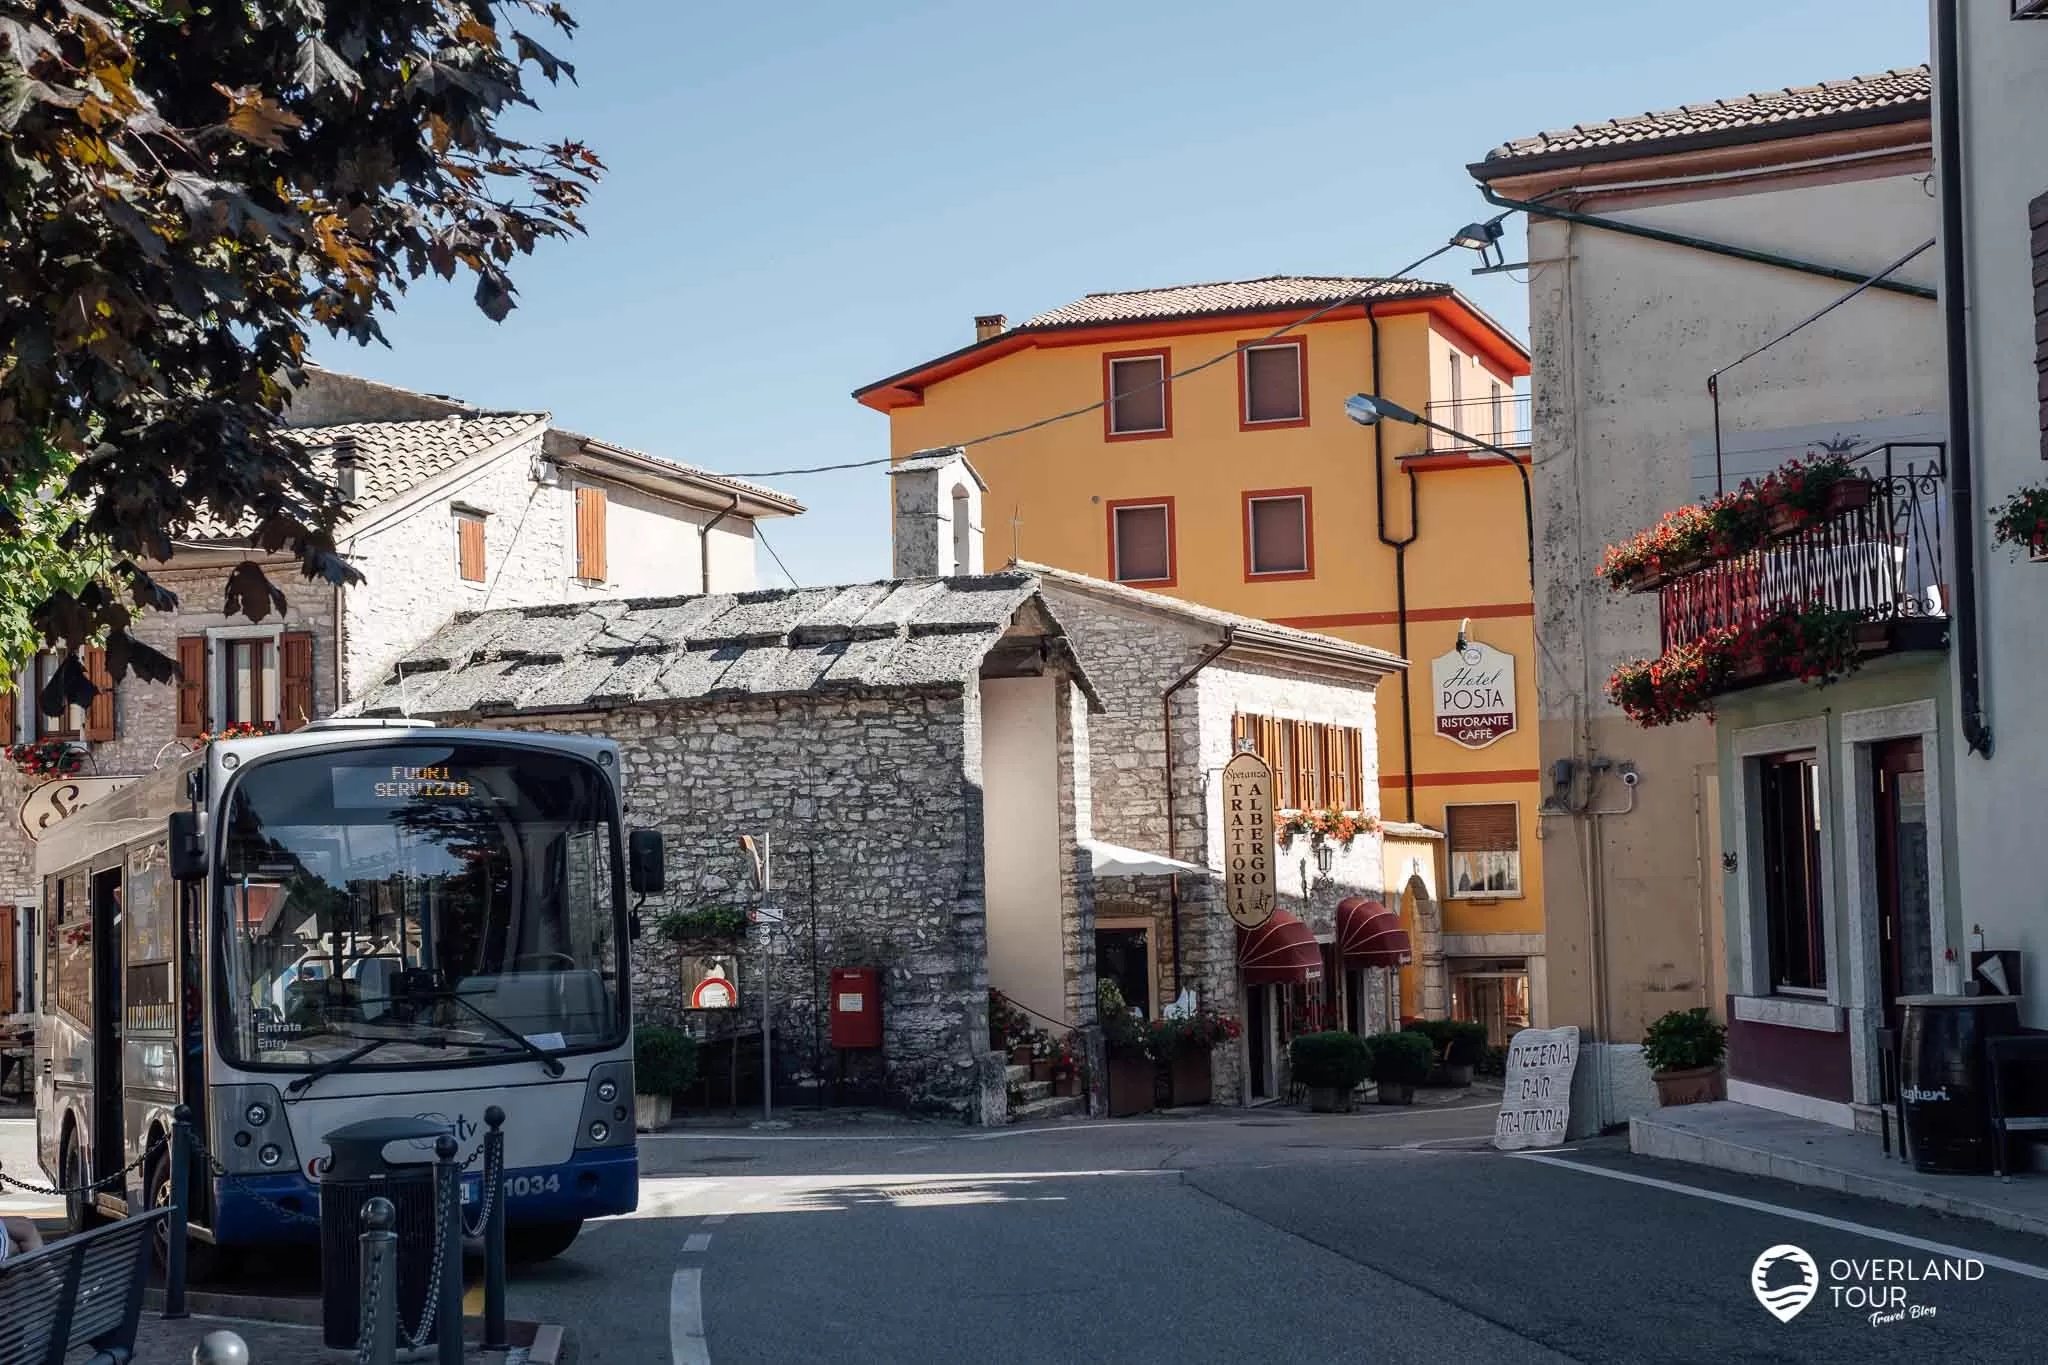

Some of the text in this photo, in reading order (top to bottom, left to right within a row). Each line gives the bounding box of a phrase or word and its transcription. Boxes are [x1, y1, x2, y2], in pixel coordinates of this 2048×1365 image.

[1443, 667, 1503, 688] Hotel
[1443, 689, 1504, 710] POSTA
[1441, 715, 1509, 728] RISTORANTE
[391, 766, 449, 780] FUORI
[1226, 768, 1266, 783] Speranza
[374, 781, 470, 797] SERVIZIO
[1248, 783, 1265, 884] ALBERGO
[1230, 784, 1246, 914] TRATTORIA
[257, 1022, 302, 1033] Entrata
[257, 1038, 288, 1050] Entry
[1511, 1041, 1570, 1068] PIZZERIA
[1522, 1076, 1550, 1100] BAR
[1499, 1109, 1564, 1133] TRATTORIA
